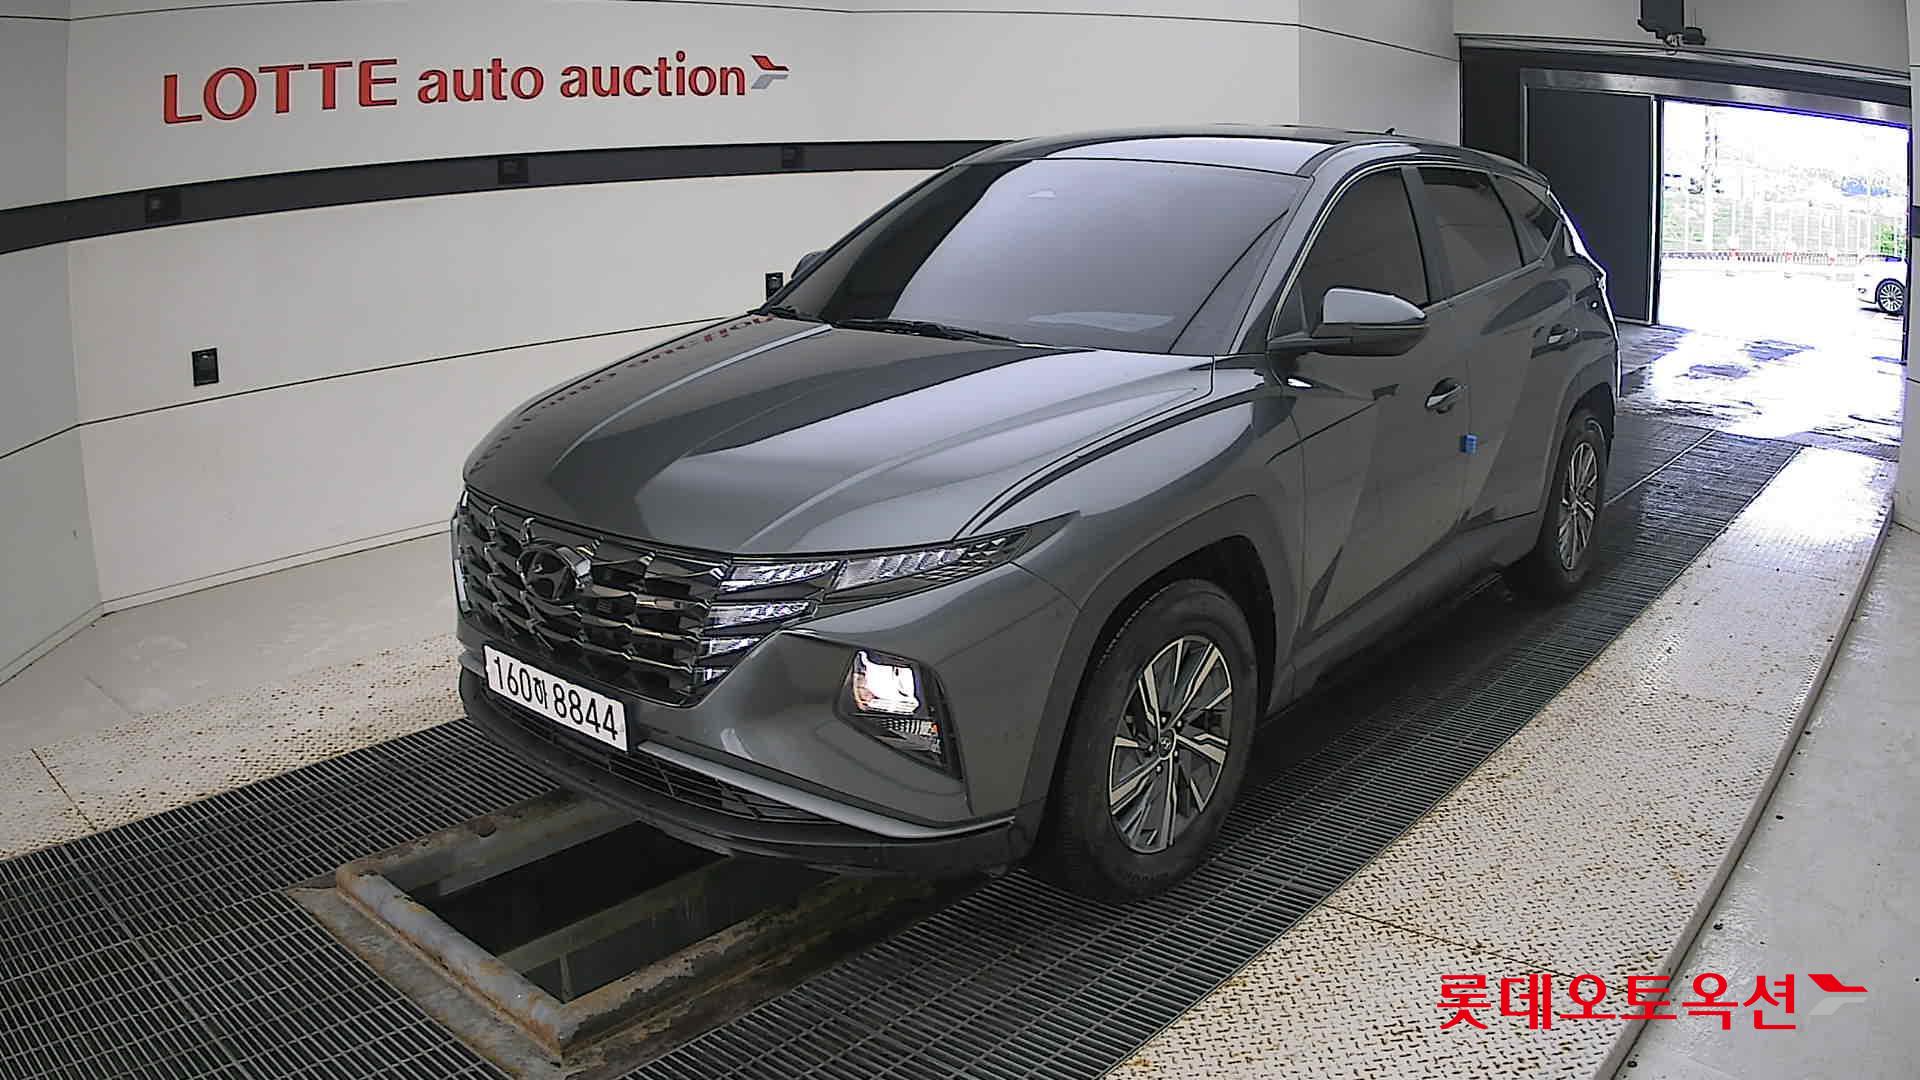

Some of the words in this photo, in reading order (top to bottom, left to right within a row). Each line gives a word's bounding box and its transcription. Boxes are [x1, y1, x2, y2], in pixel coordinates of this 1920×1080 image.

[163, 58, 398, 125] LOTTE
[417, 58, 545, 104] auto
[560, 50, 747, 98] auction
